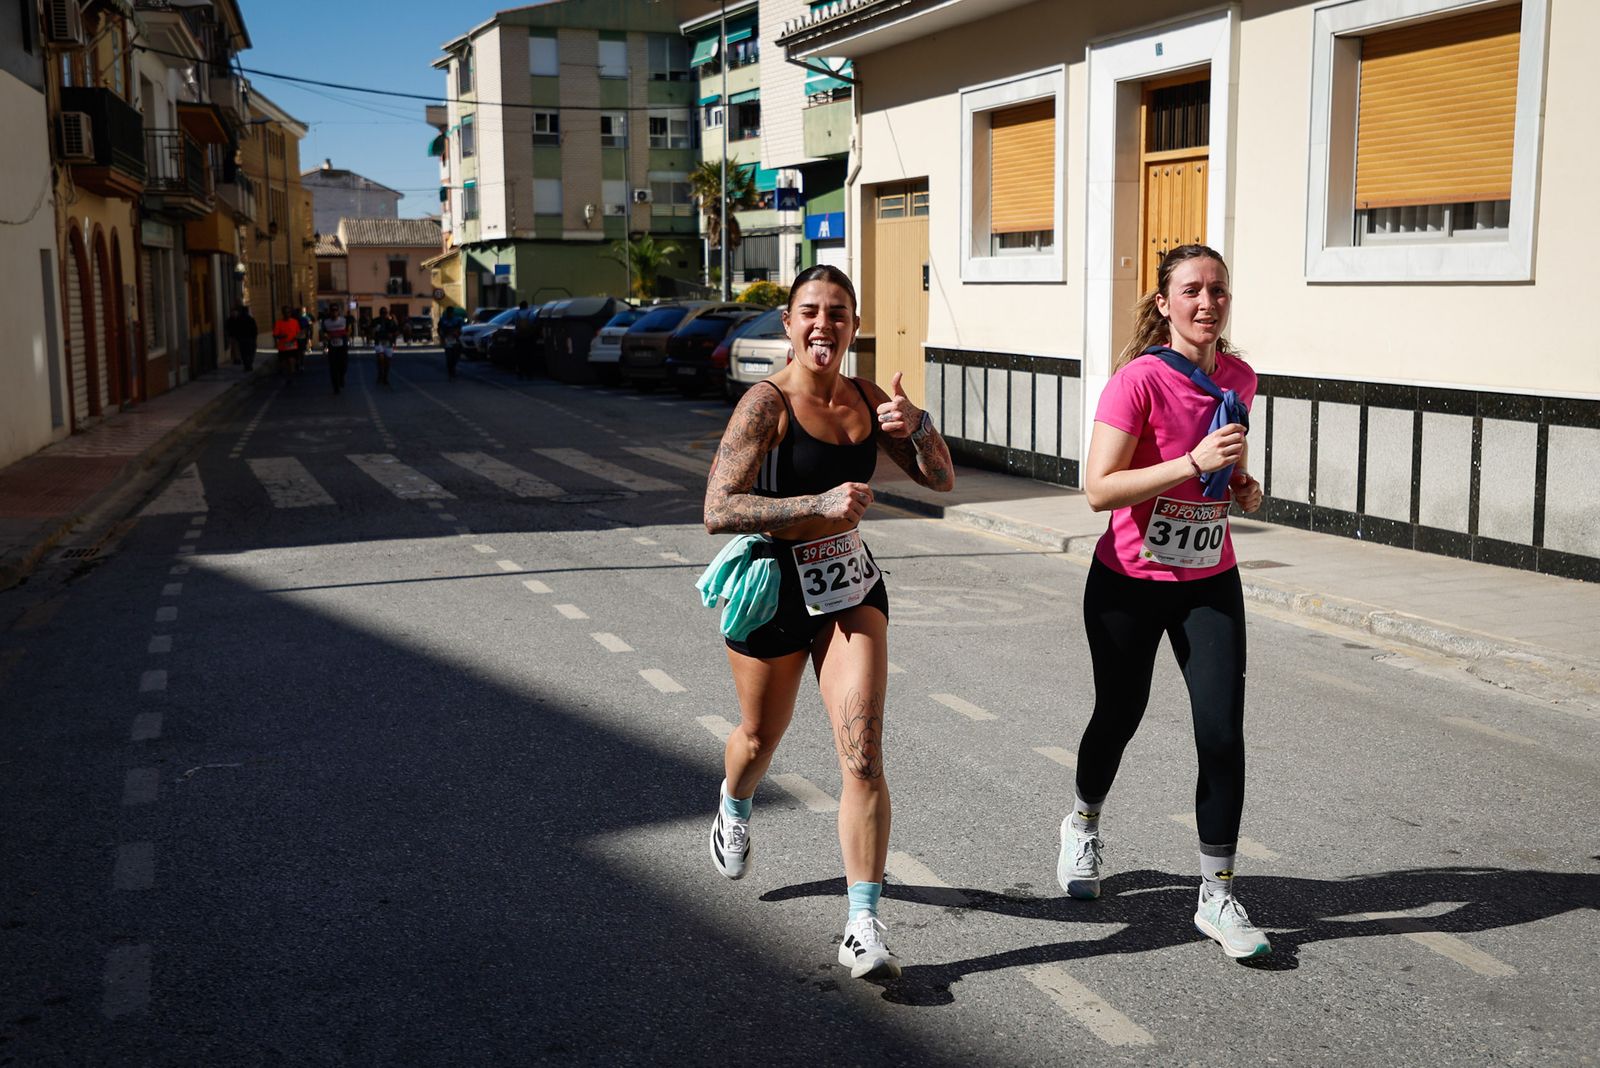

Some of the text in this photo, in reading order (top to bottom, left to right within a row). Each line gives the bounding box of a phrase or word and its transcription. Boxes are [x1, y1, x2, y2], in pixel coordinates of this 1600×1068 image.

[1160, 503, 1178, 514] 39
[1175, 509, 1216, 520] FONDO
[1148, 521, 1224, 552] 3100
[802, 547, 817, 561] 39
[819, 539, 857, 559] FONDO
[803, 553, 875, 596] 3230
